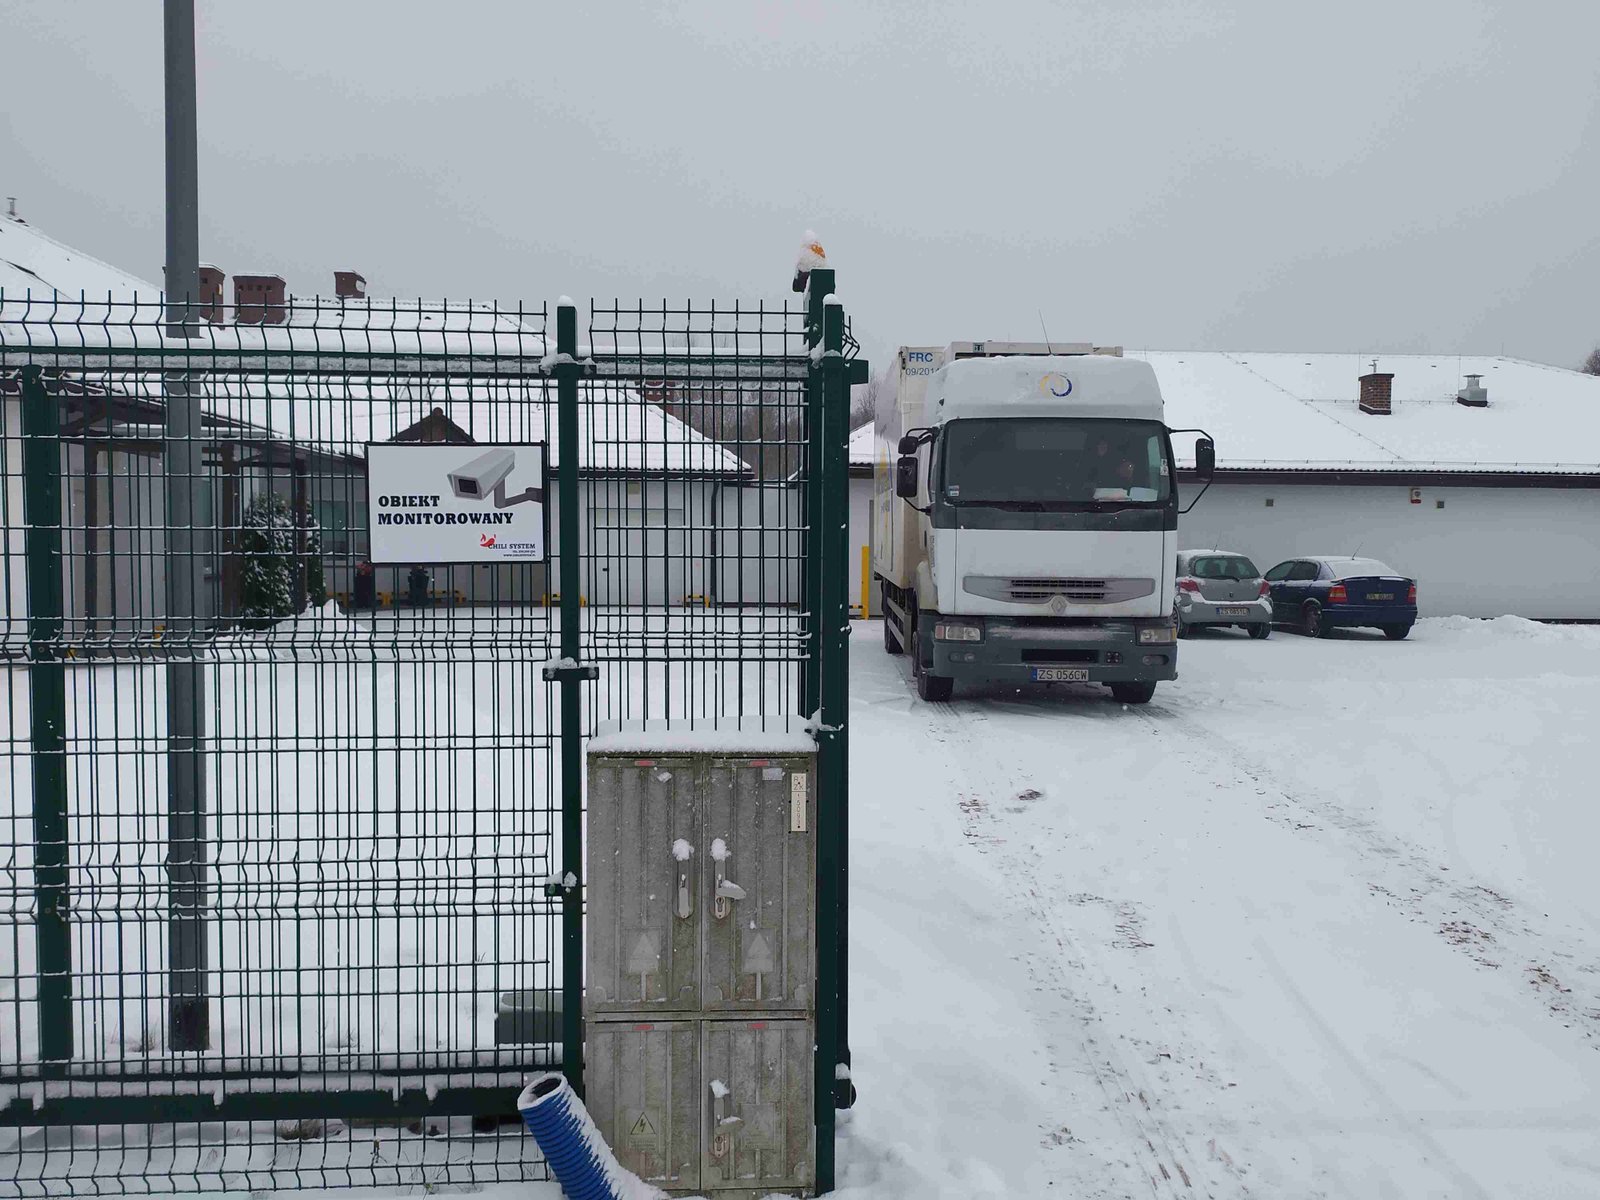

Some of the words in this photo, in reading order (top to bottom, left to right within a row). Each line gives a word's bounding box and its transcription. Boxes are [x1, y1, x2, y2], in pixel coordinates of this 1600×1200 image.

[909, 352, 933, 362] FRC
[378, 495, 440, 507] OBIEKT
[378, 512, 514, 525] MONITOROWANY
[1038, 670, 1053, 680] ZS
